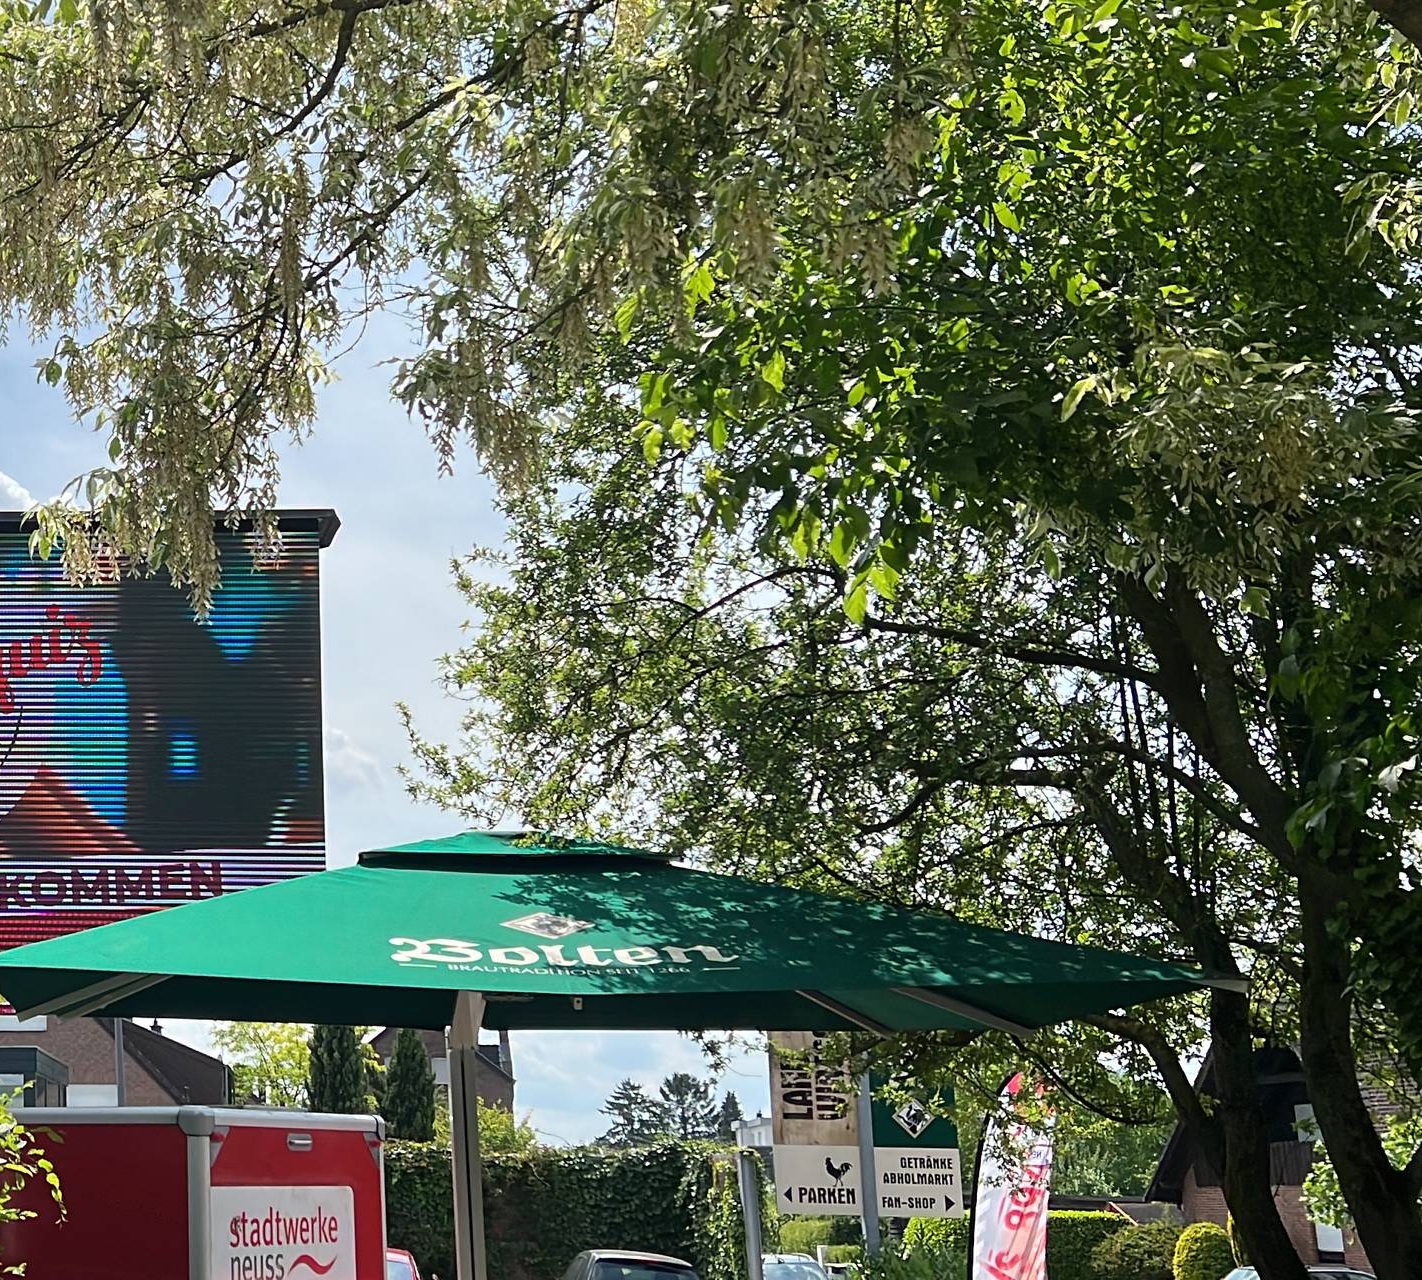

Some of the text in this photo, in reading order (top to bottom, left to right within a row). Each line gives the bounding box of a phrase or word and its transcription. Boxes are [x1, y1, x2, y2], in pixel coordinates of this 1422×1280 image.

[389, 937, 739, 966] Bolten
[447, 964, 602, 977] BRAUTRADITION
[900, 1155, 954, 1170] GETRÄNKE
[883, 1172, 955, 1186] ABHOLMARKT
[798, 1187, 857, 1205] PARKEN
[881, 1196, 937, 1210] FAN-SHOP
[230, 1206, 338, 1248] stadtwerke
[230, 1253, 285, 1280] neuss
